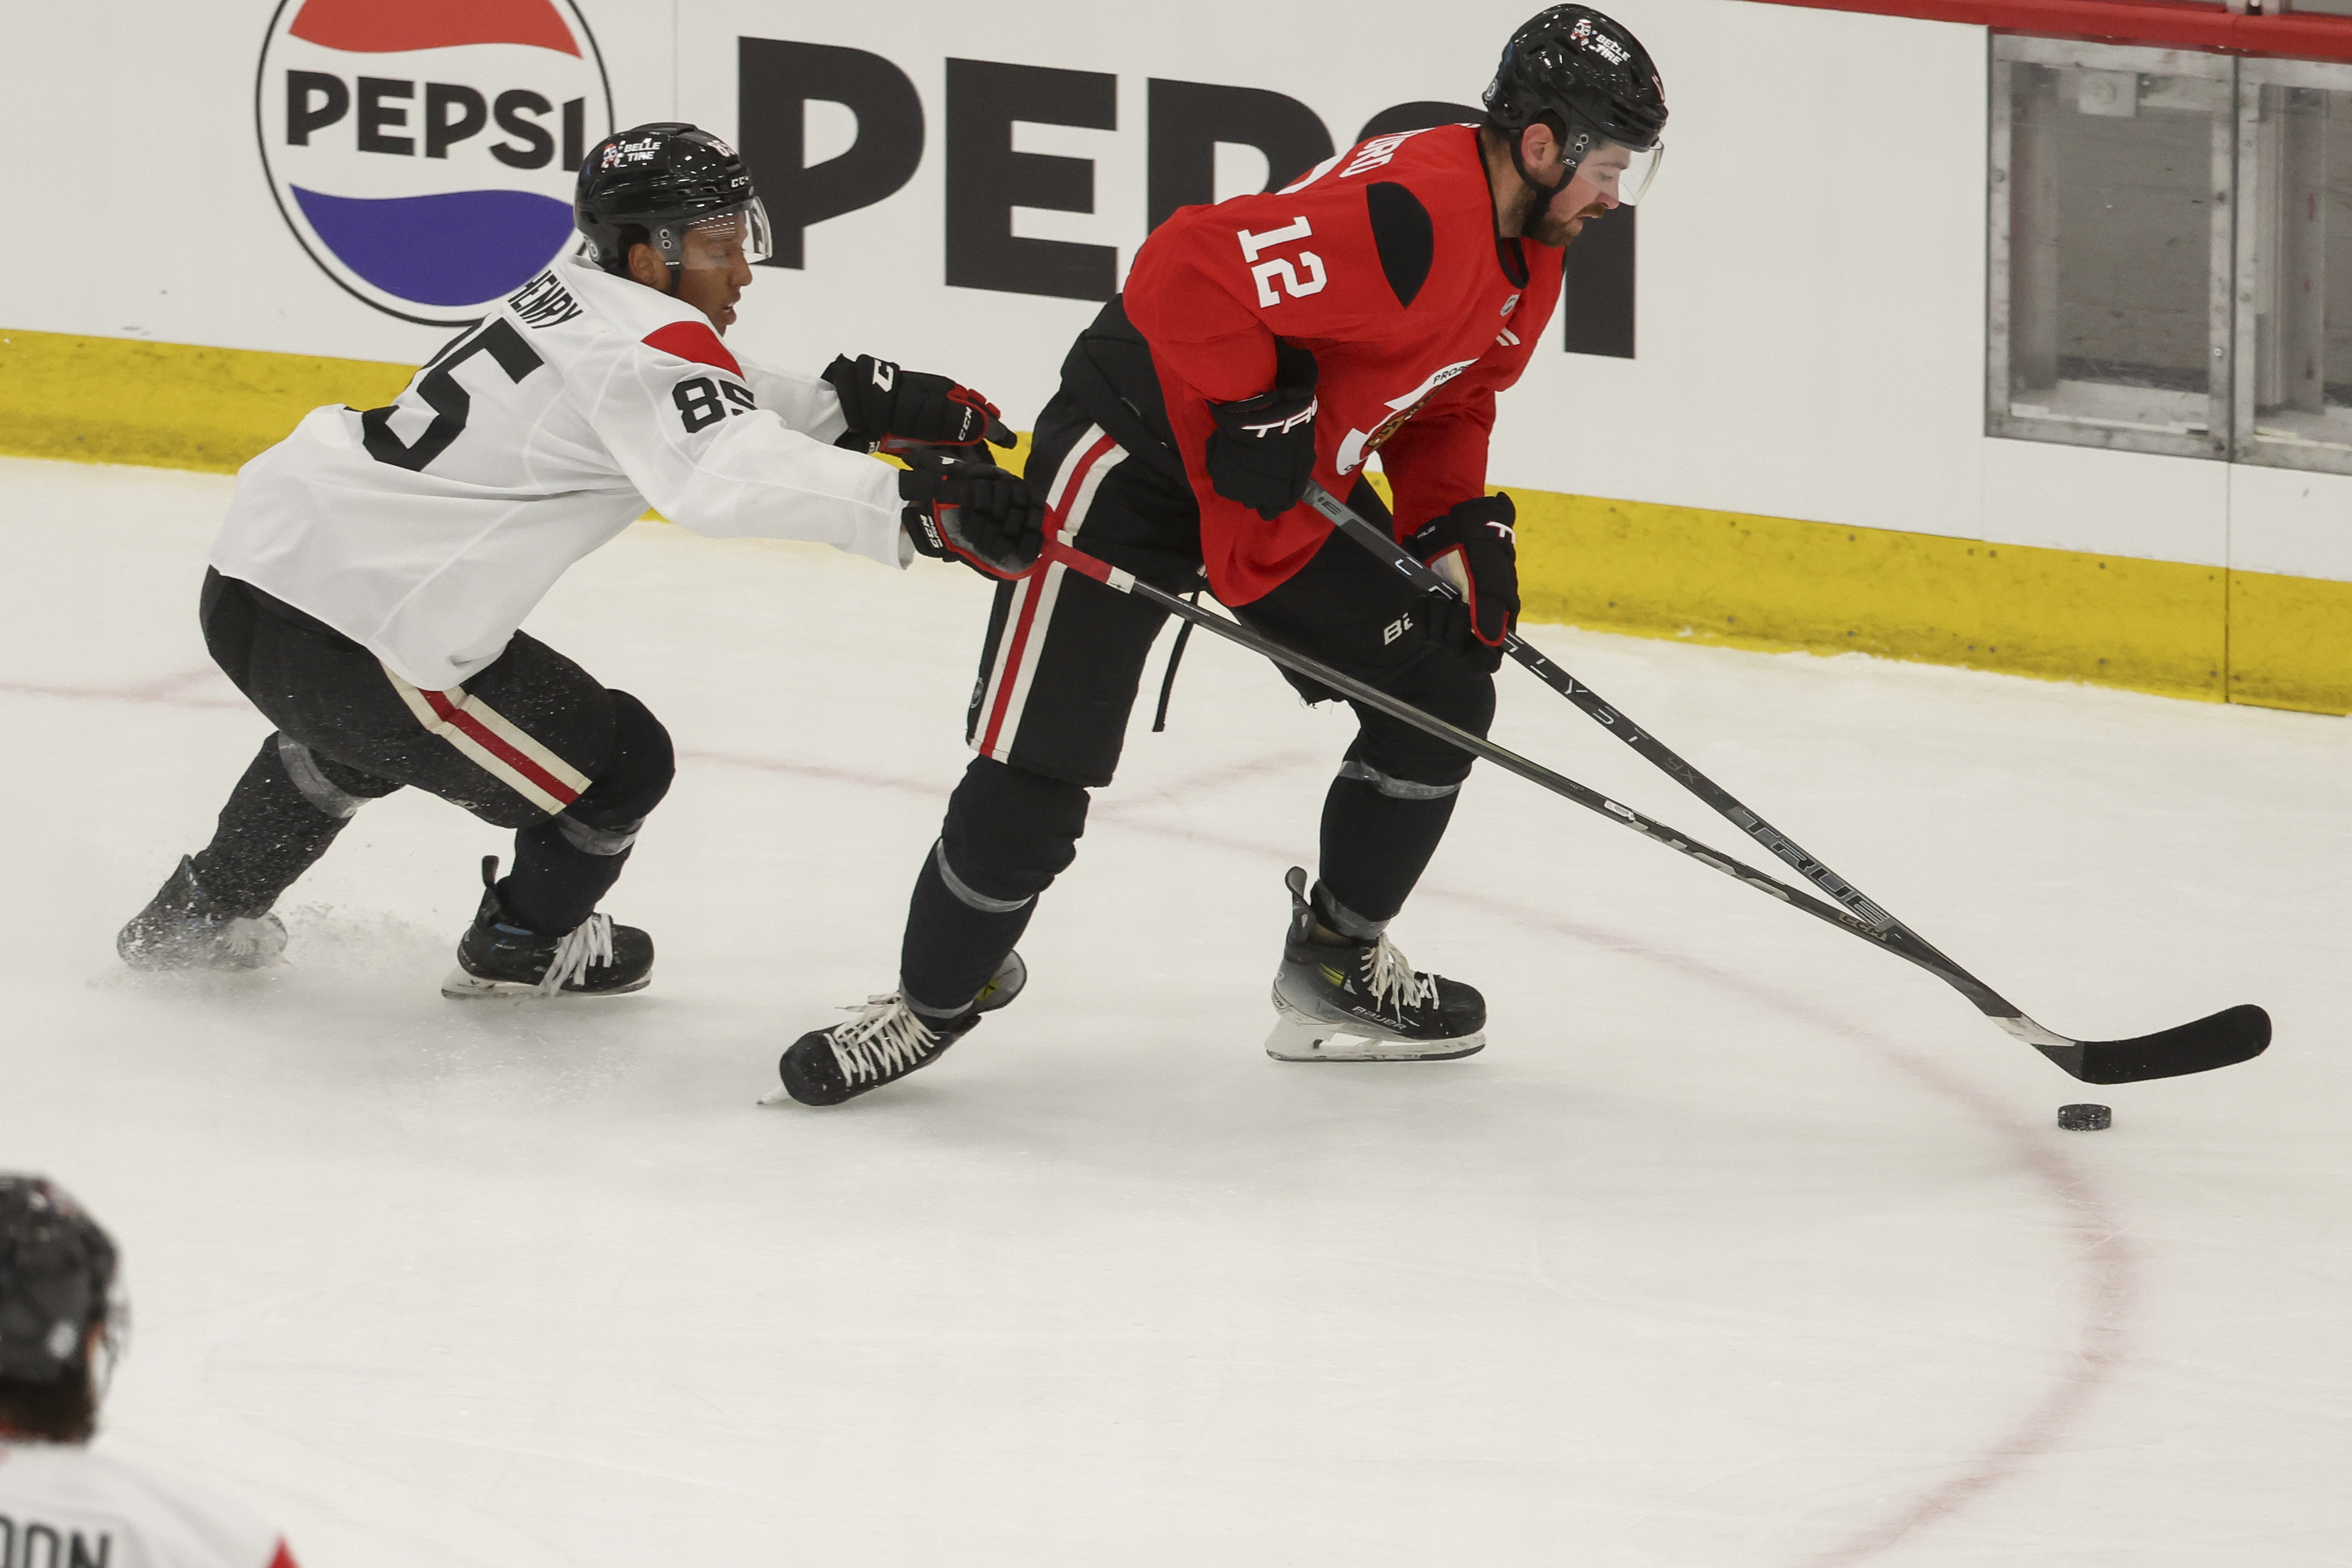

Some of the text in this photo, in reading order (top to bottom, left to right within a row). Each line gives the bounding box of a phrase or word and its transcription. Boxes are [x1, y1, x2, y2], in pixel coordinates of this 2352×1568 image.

[1595, 34, 1631, 61] BELLE
[1595, 44, 1622, 65] TIRE
[286, 70, 584, 172] PEPSI
[624, 142, 662, 153] BELLE
[627, 151, 655, 162] TIRE
[739, 36, 1635, 358] PEPI
[1237, 215, 1328, 309] 12
[507, 269, 584, 329] HENRY
[344, 316, 545, 472] 5
[958, 407, 973, 441] CCM
[919, 514, 940, 548] CCM
[1743, 810, 1889, 926] TRUE
[1838, 913, 1888, 942] CCM
